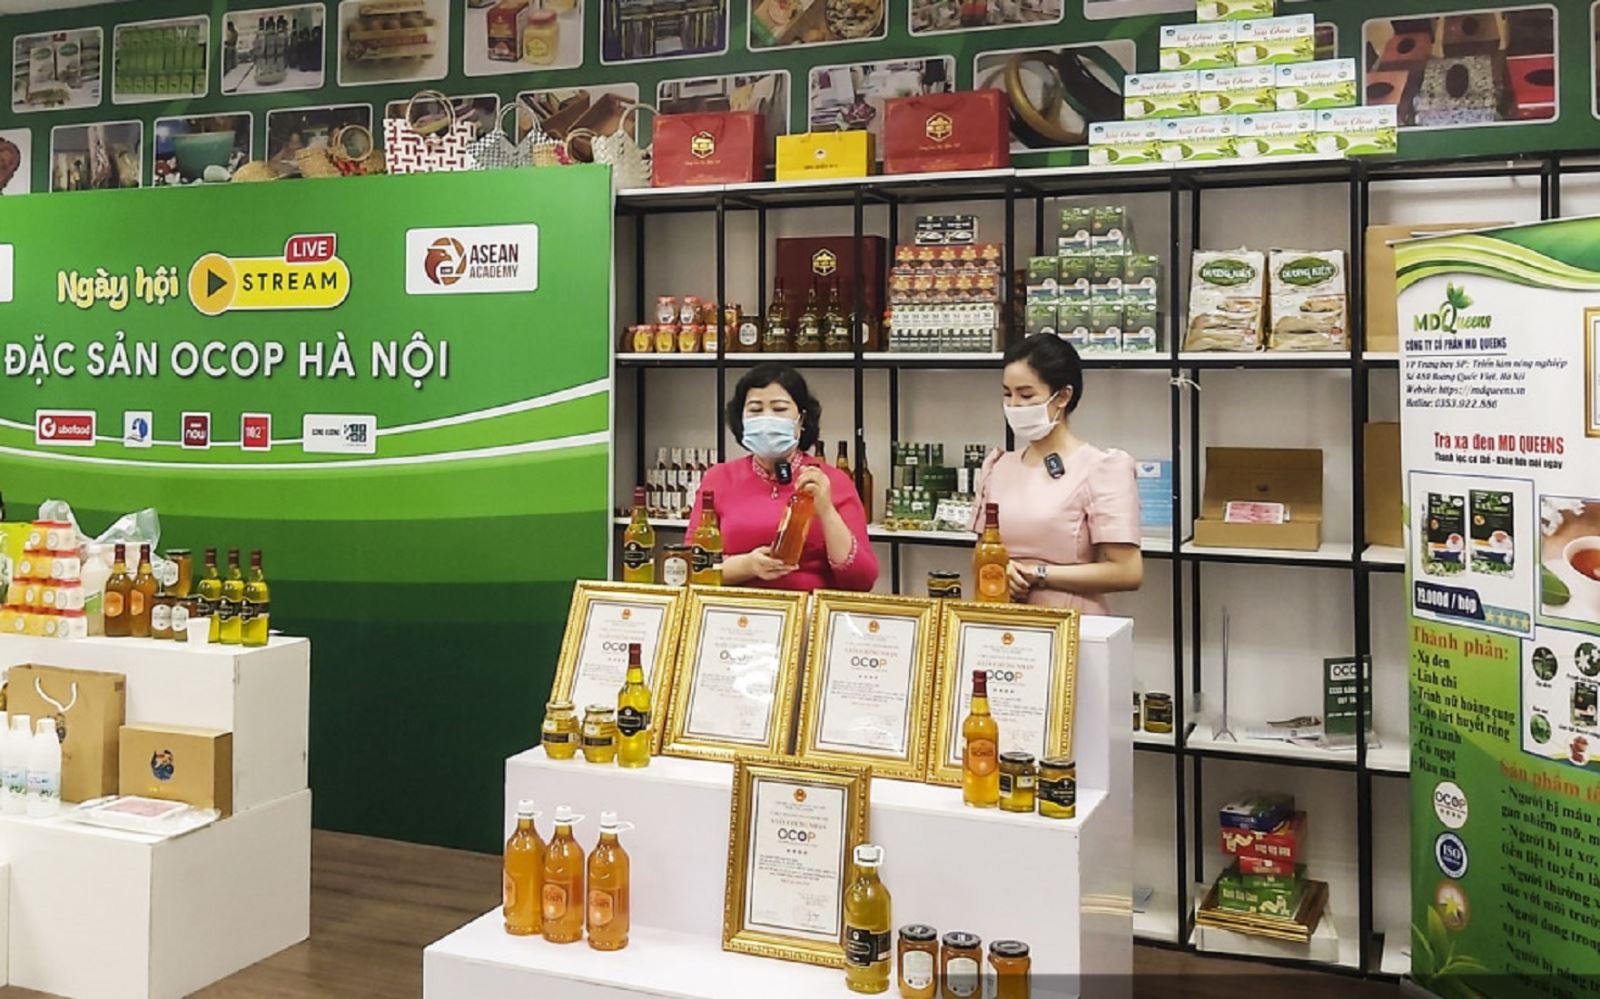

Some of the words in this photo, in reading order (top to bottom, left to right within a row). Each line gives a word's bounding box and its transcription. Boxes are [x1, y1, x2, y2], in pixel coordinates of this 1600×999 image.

[293, 240, 327, 257] LIVE
[470, 243, 519, 264] ASEAN
[469, 265, 519, 279] ACADEMY
[57, 267, 129, 310] Ngày
[135, 265, 179, 305] hội
[242, 271, 337, 292] STREAM
[1465, 338, 1477, 349] MD
[1480, 337, 1507, 350] QUEENS
[4, 333, 76, 385] ĐẶC
[86, 330, 158, 377] SẢN
[170, 341, 285, 377] OCOP
[299, 331, 357, 378] HÀ
[371, 330, 449, 388] NỘI
[1473, 433, 1495, 451] đen
[1498, 434, 1516, 452] MD
[1519, 435, 1564, 455] QUEENS
[602, 641, 627, 652] OCO
[1413, 626, 1458, 650] Thành
[851, 656, 887, 669] OCOP
[1333, 665, 1358, 676] OCO
[1441, 674, 1457, 689] chi
[1435, 790, 1466, 809] OCOP
[1563, 808, 1592, 823] máu
[777, 828, 816, 843] OCOP
[1443, 843, 1461, 860] ISO
